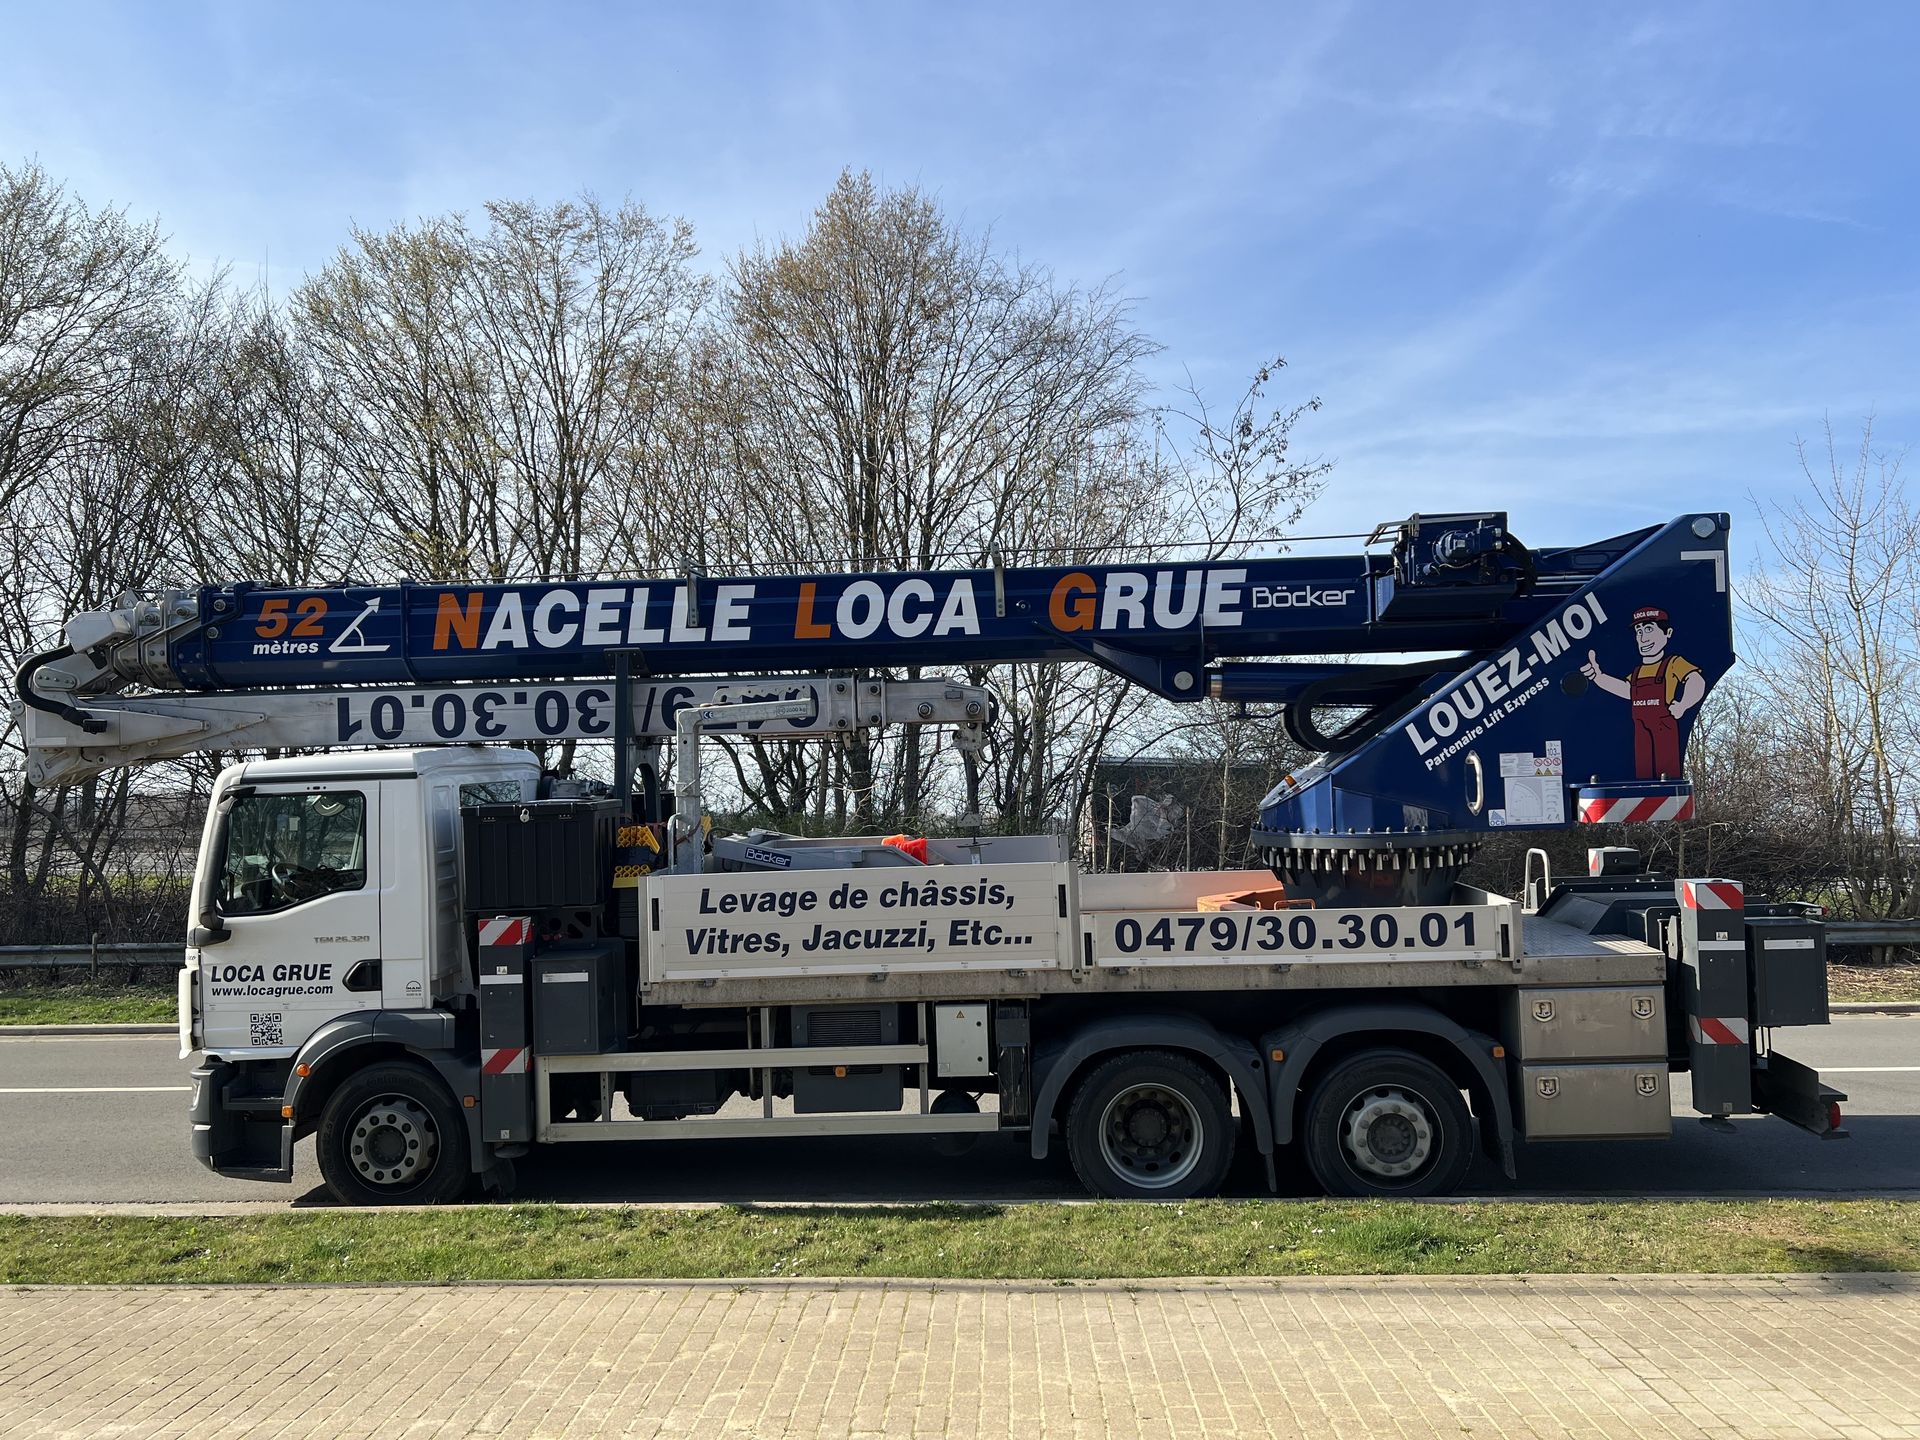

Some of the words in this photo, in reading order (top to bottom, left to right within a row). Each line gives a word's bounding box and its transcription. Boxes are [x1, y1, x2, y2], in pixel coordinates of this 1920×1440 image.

[432, 584, 756, 650] NACELLE
[794, 578, 981, 639] LOCA
[1048, 568, 1248, 632] GRUE
[1252, 585, 1355, 608] Böcker
[1633, 611, 1646, 619] LOCA
[255, 597, 328, 638] 52
[253, 640, 319, 655] mètres
[1404, 591, 1608, 756] LOUEZ-MOI
[1424, 725, 1484, 771] Partenaire
[1482, 707, 1505, 729] Lift
[1503, 676, 1550, 713] Express
[745, 848, 791, 867] Böcker
[699, 887, 818, 917] Levage
[828, 883, 868, 910] de
[879, 878, 1015, 911] châssis,
[685, 928, 791, 957] Vitres,
[802, 920, 936, 952] Jacuzzi,
[948, 919, 1033, 947] Etc...
[1114, 911, 1475, 953] 0479/30.30.01
[211, 965, 265, 983] LOCA
[272, 963, 332, 981] GRUE
[211, 984, 333, 998] www.locagrue.com
